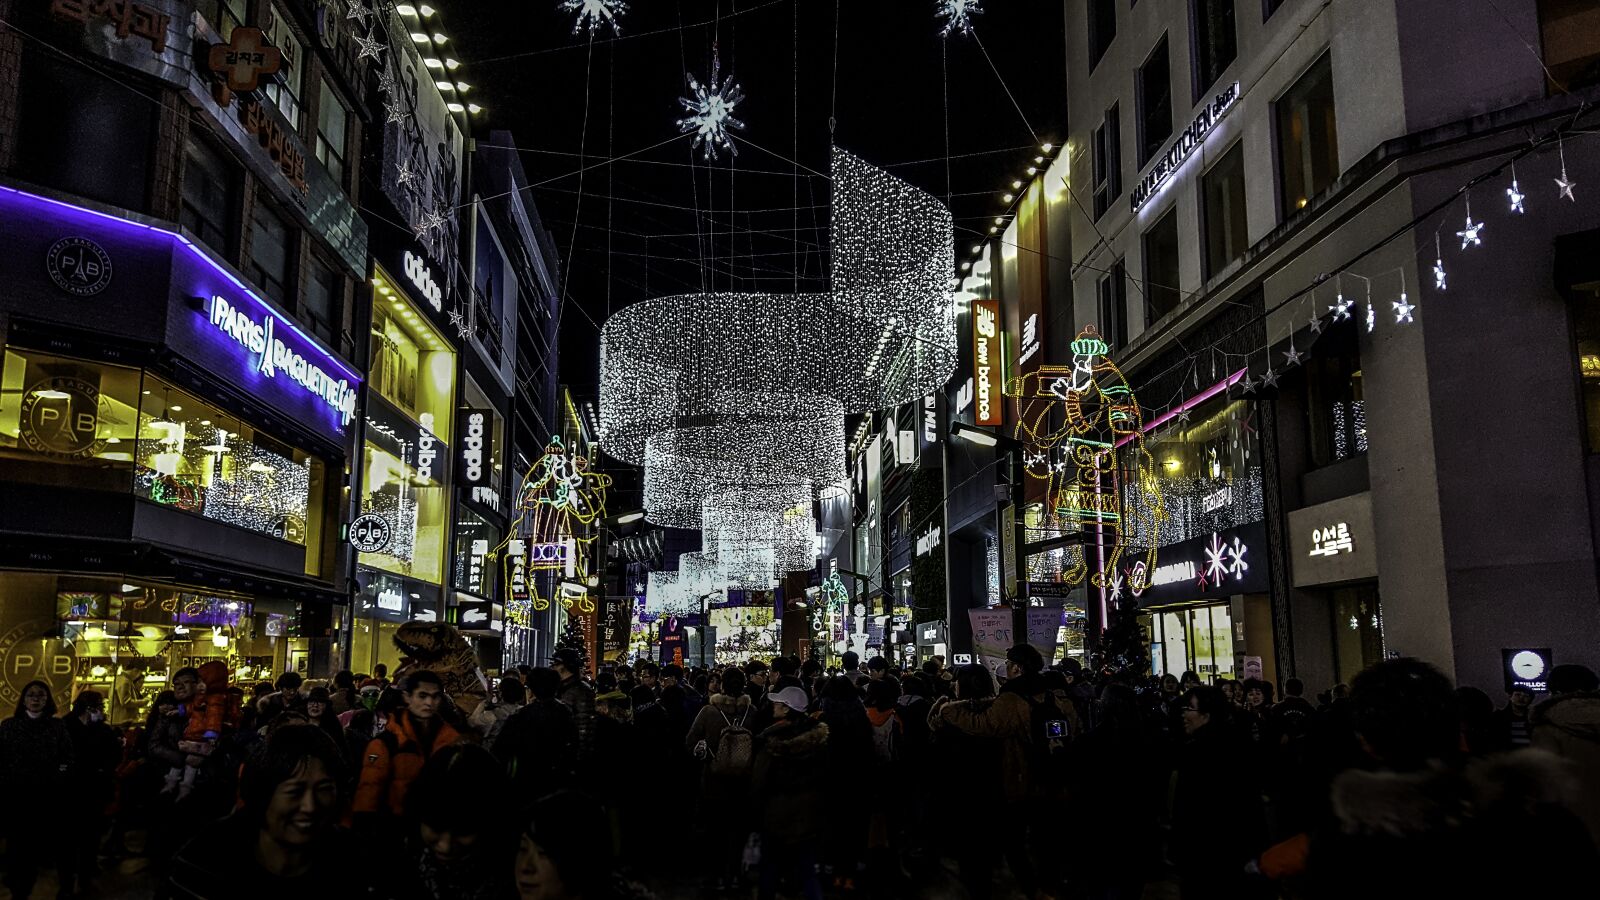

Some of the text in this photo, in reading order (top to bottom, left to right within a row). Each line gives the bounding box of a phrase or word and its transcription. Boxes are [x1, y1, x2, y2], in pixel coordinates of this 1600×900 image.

[1166, 104, 1212, 171] KITCHEN
[404, 250, 441, 312] adidas
[210, 295, 264, 353] PARIS
[273, 338, 339, 410] BAGUETTE
[977, 338, 992, 421] new balance
[467, 413, 483, 481] adidas
[925, 410, 936, 442] MLB
[1309, 523, 1353, 557] 오설록
